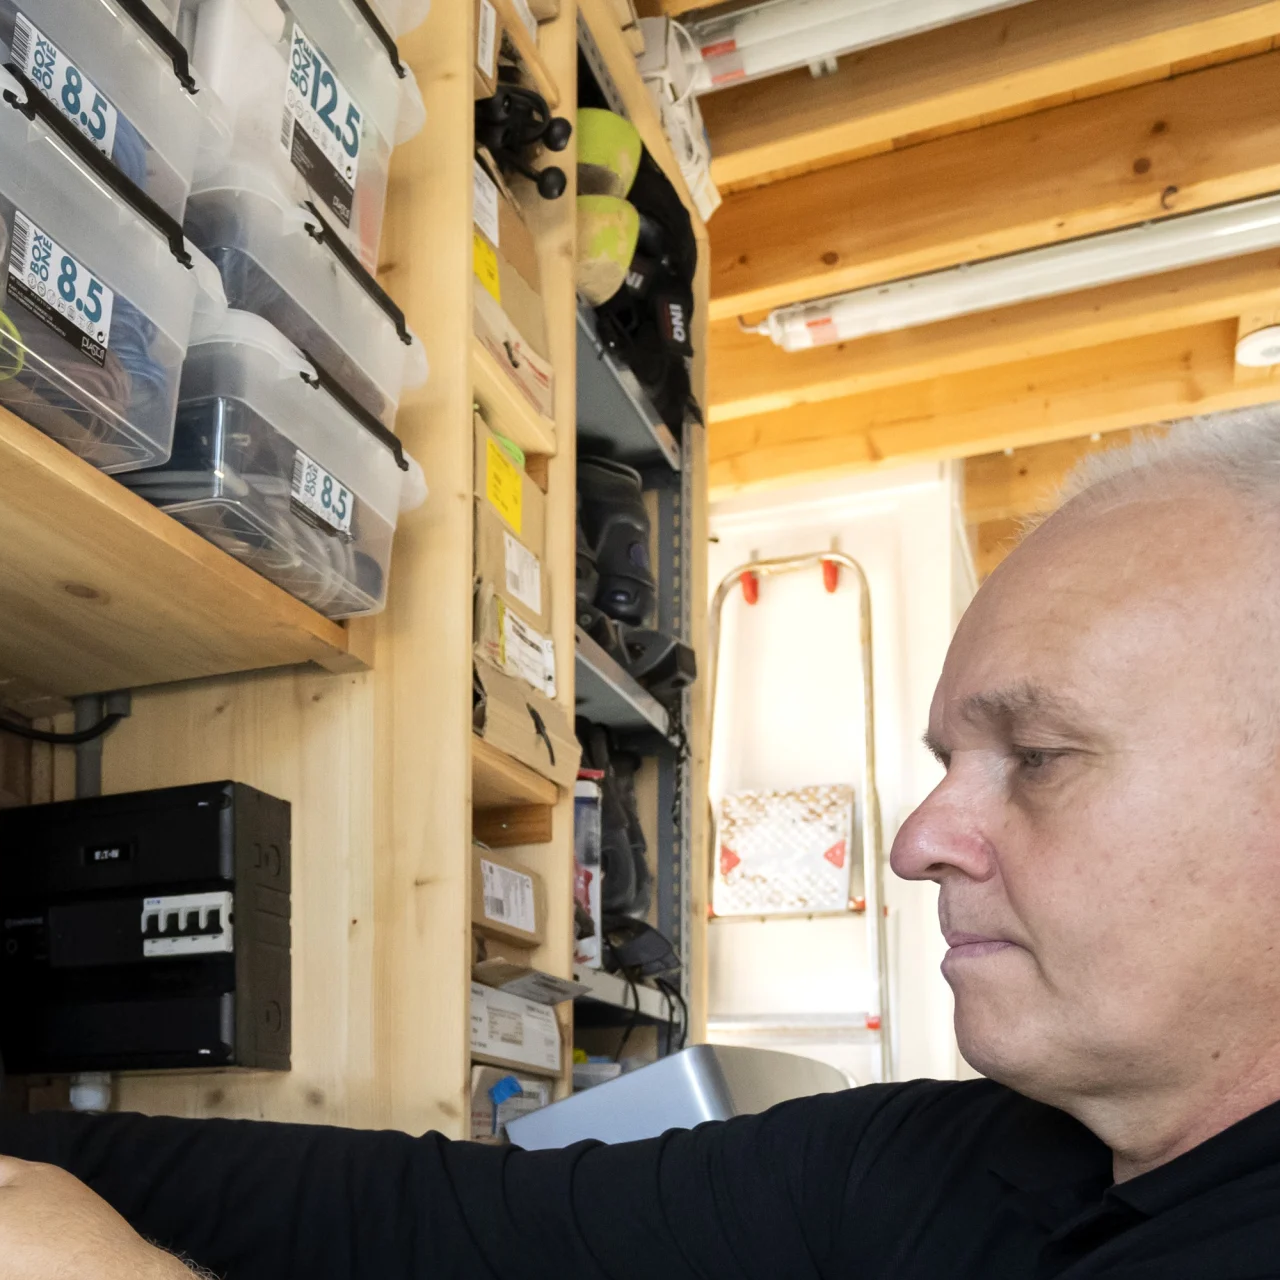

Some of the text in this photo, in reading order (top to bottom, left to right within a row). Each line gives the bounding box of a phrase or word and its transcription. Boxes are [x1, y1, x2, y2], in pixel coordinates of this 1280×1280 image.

[32, 33, 47, 82] BOX
[42, 43, 57, 90] ONE
[290, 31, 304, 88] BOX
[298, 42, 312, 97] ONE
[61, 66, 108, 140] 8.5
[311, 53, 361, 158] 12.5
[30, 229, 44, 275] BOX
[39, 238, 53, 282] ONE
[57, 256, 104, 323] 8.5
[304, 461, 314, 494] BOX
[309, 467, 319, 497] ONE
[321, 475, 348, 520] 8.5
